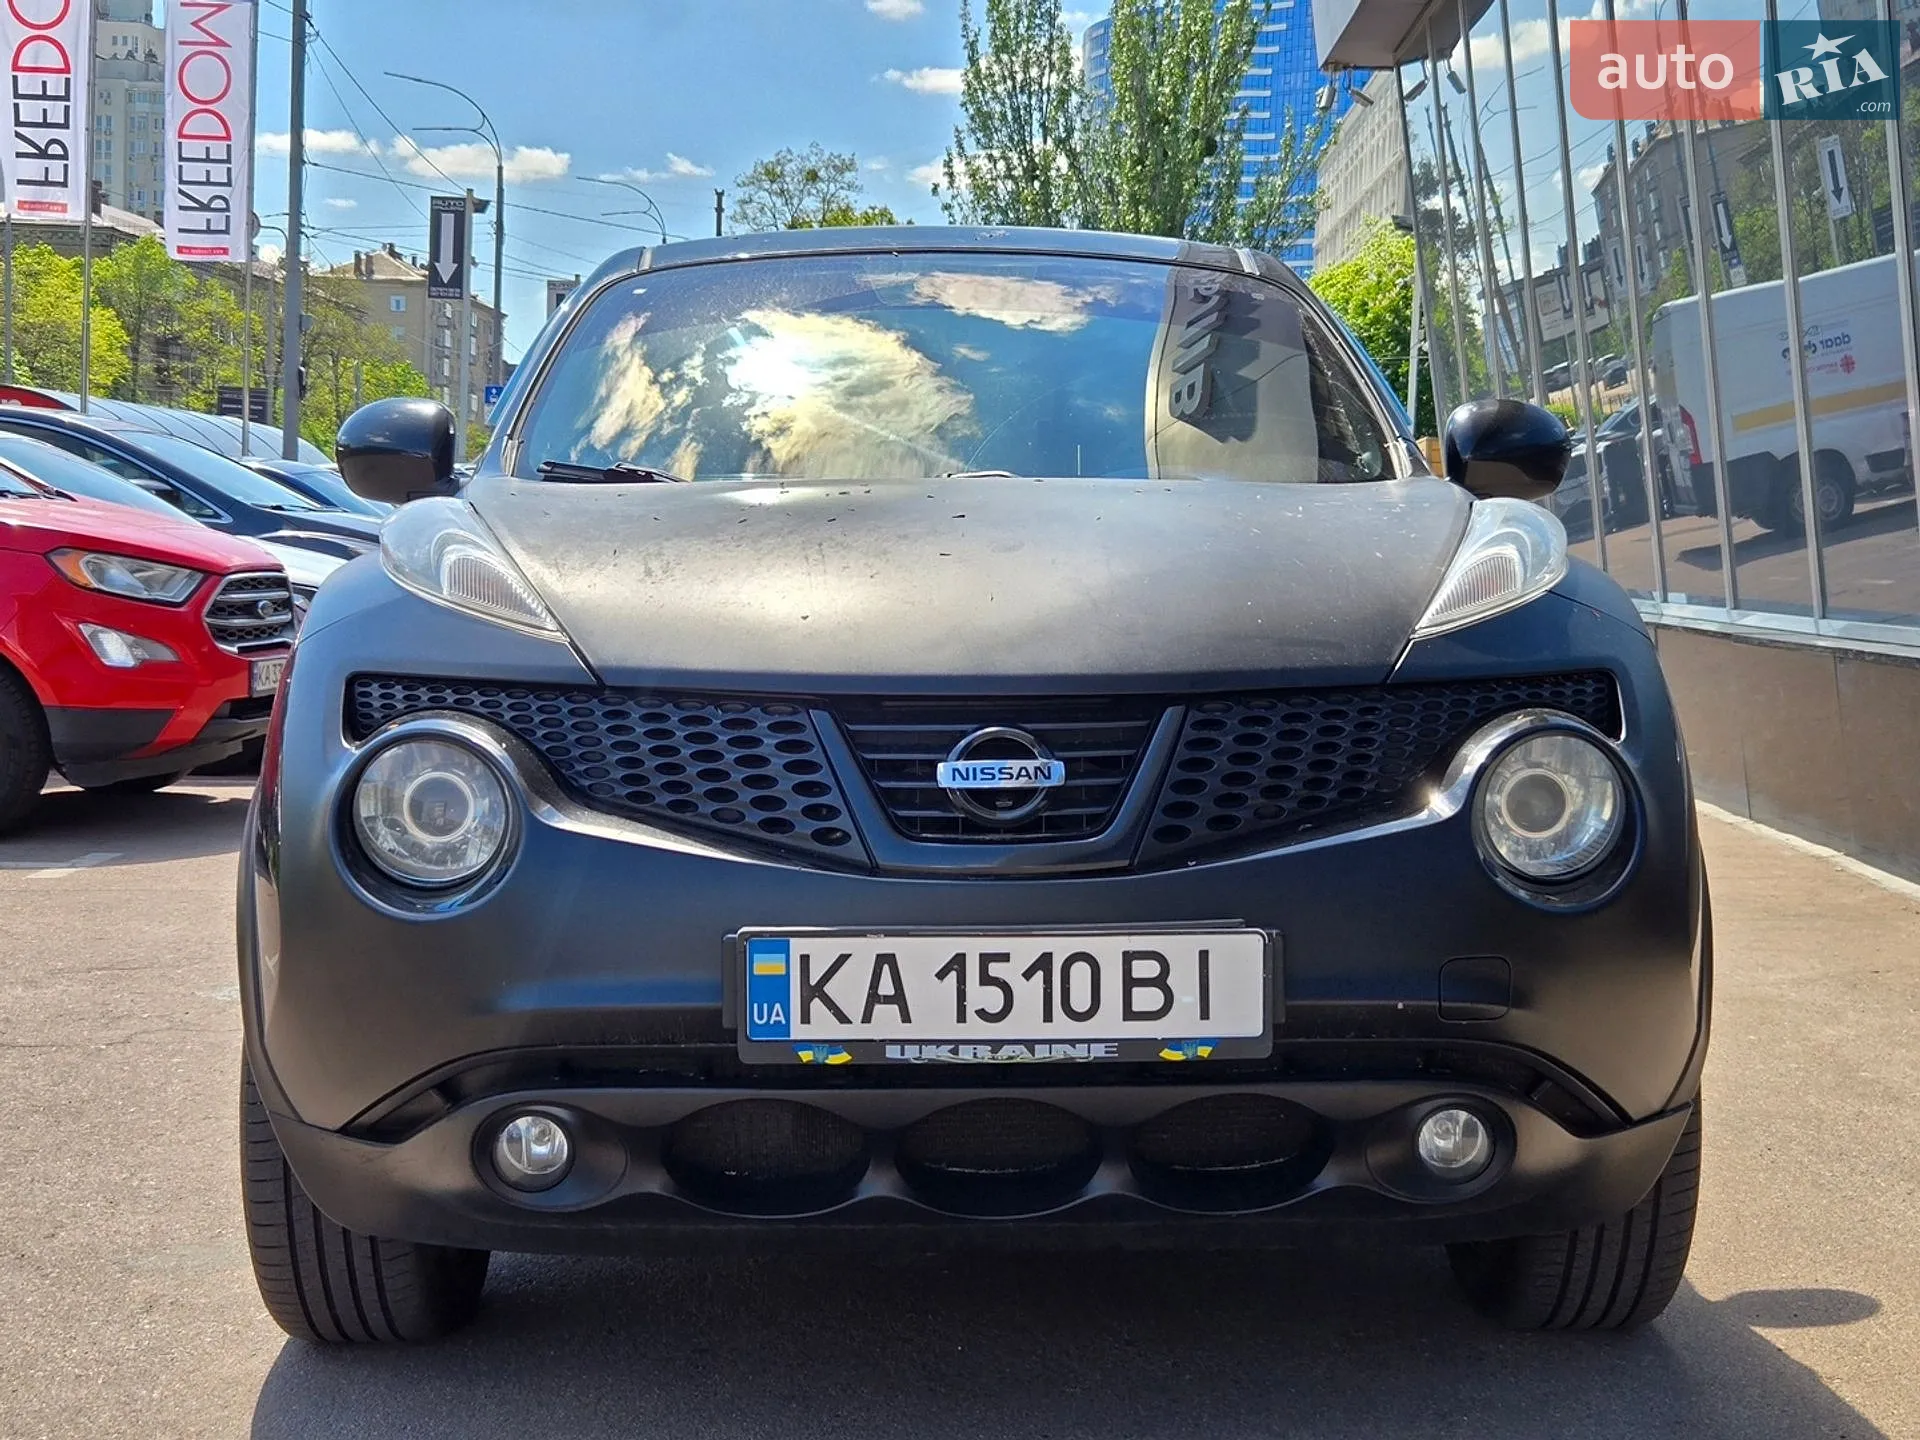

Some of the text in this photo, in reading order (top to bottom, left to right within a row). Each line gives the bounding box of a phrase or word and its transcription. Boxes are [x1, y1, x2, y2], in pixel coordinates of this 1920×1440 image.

[951, 765, 1052, 782] NISSAN
[800, 949, 1210, 1025] KA 1510 BI
[753, 1003, 786, 1025] UA
[885, 1042, 1119, 1060] UKRAINE
